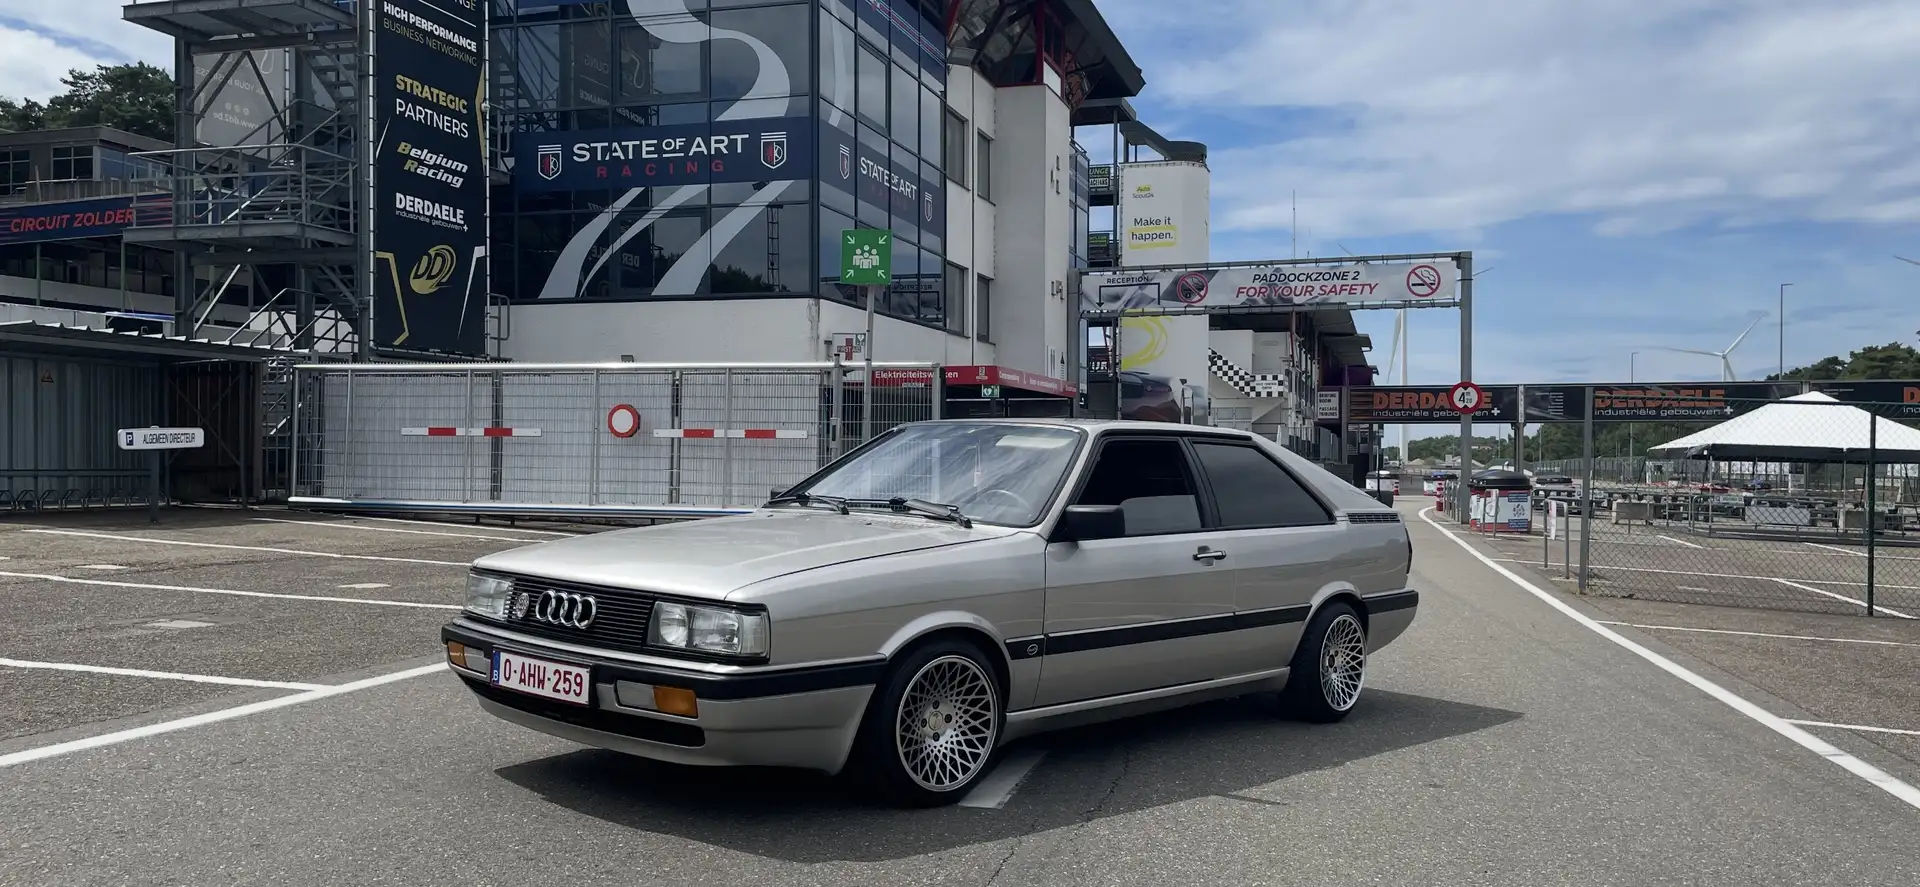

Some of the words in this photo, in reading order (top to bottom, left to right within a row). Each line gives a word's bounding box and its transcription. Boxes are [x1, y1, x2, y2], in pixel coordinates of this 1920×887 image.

[383, 1, 408, 22] HIGH
[409, 12, 477, 52] PERFORMANCE
[383, 18, 424, 44] BUSINESS
[426, 36, 477, 67] NETWORKING
[395, 74, 468, 115] STRATEGIC
[396, 98, 469, 139] PARTNERS
[397, 141, 469, 174] Belgium
[572, 139, 658, 163] STATE
[662, 137, 687, 151] OF
[688, 133, 750, 157] ART
[403, 159, 465, 189] Racing
[595, 159, 725, 178] RACING
[859, 156, 891, 188] STATE
[899, 178, 918, 201] ART
[395, 192, 465, 225] DERDAELE
[10, 214, 71, 233] CIRCUIT
[73, 208, 135, 228] ZOLDER
[1133, 217, 1162, 227] Make
[1164, 216, 1172, 226] it
[1131, 231, 1174, 242] happen.
[1106, 275, 1149, 285] RECEPTION
[1252, 270, 1350, 284] PADDOCKZONE
[1351, 270, 1361, 281] 2
[1235, 286, 1268, 298] FOR
[1272, 284, 1315, 297] YOUR
[1317, 283, 1379, 296] SAFETY
[1373, 391, 1493, 409] DERDAE
[1458, 391, 1466, 404] 4
[1594, 389, 1725, 408] DERDAELE
[1372, 409, 1429, 417] industriële
[1594, 407, 1656, 416] industriële
[1660, 408, 1722, 417] gebouwen
[142, 433, 168, 444] ALGEMEEN
[169, 432, 196, 443] DIRECTEUR
[493, 670, 499, 680] B
